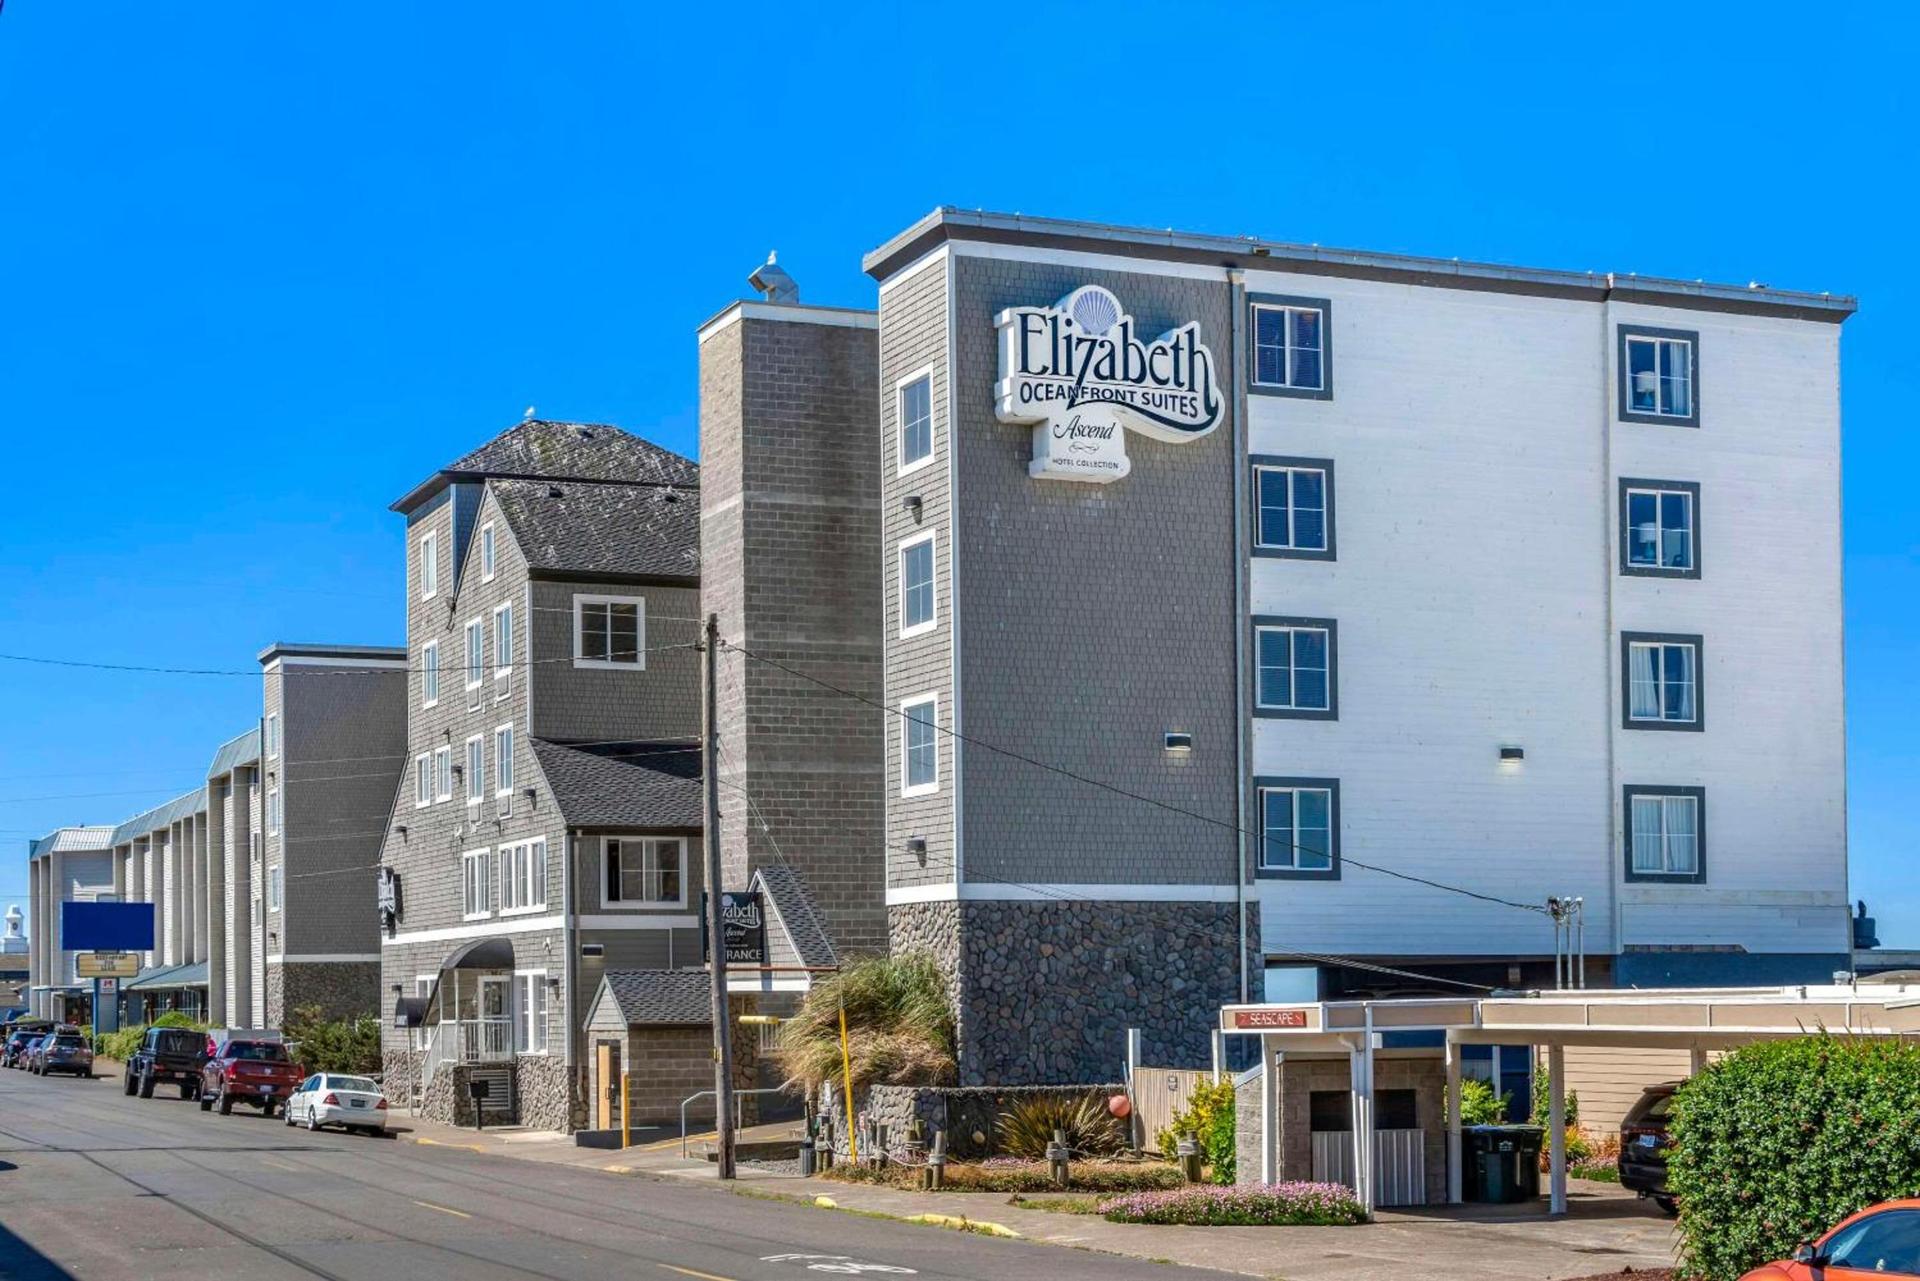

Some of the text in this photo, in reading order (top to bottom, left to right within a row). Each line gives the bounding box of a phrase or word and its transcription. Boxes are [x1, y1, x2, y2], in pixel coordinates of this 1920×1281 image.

[1017, 312, 1219, 420] Elizabeth
[1020, 381, 1198, 419] OCEANFRONT SUITES
[1053, 414, 1116, 440] Ascend
[1052, 458, 1119, 469] HOTEL COLLECTION
[706, 949, 763, 961] ERANCE
[1249, 1012, 1294, 1026] SEASCAPE
